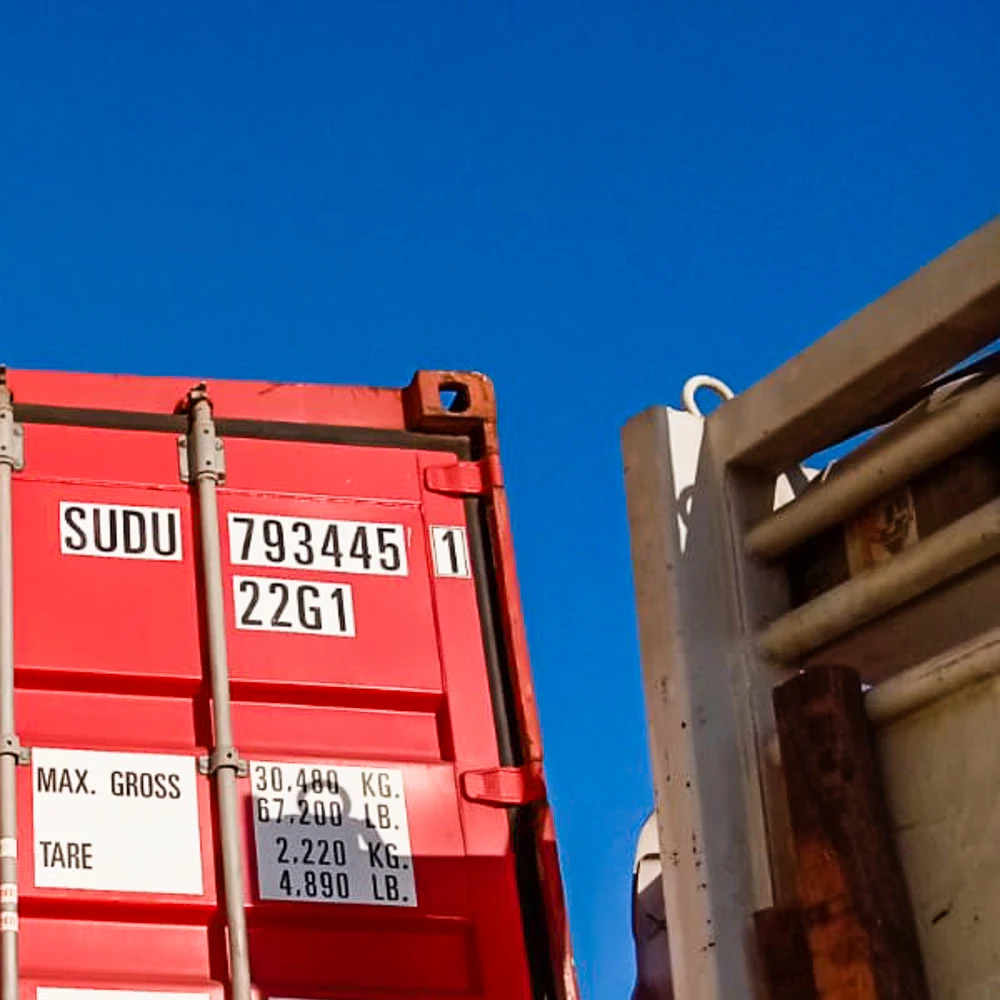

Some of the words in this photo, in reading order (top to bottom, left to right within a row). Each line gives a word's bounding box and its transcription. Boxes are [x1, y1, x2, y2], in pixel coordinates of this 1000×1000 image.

[64, 506, 178, 556] SUDU
[233, 517, 402, 571] 793445
[441, 530, 460, 573] 1
[239, 581, 347, 632] 22G1
[37, 767, 97, 796] MAX.
[111, 770, 181, 799] GROSS
[361, 772, 401, 799] KG.
[364, 803, 401, 831] LB.
[39, 841, 94, 870] TARE
[367, 842, 410, 871] KG.
[372, 875, 409, 902] LB.
